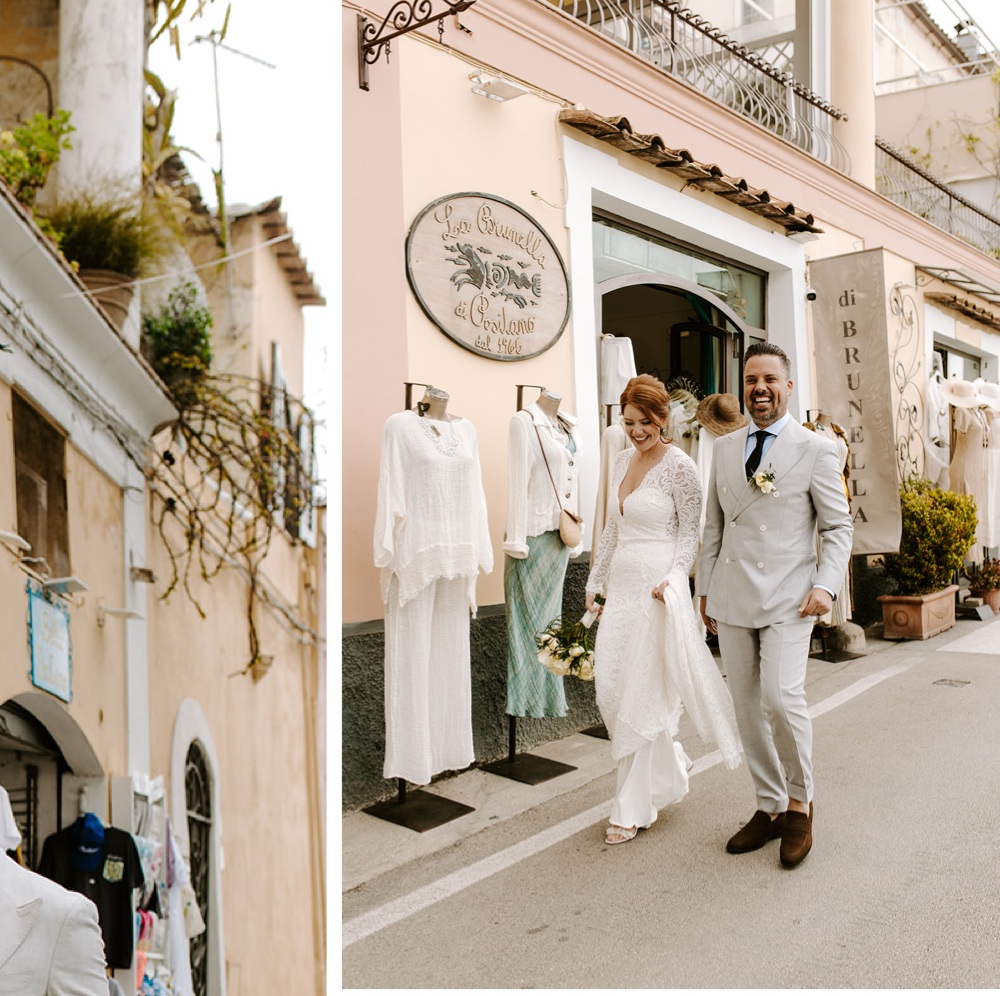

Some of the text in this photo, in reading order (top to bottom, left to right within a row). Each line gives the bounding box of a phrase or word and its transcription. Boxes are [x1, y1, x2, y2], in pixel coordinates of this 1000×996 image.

[434, 201, 550, 270] La Brunella
[454, 291, 536, 337] di Positano
[838, 288, 857, 308] di
[474, 335, 522, 355] dal 1965
[842, 319, 869, 524] BRUNELLA
